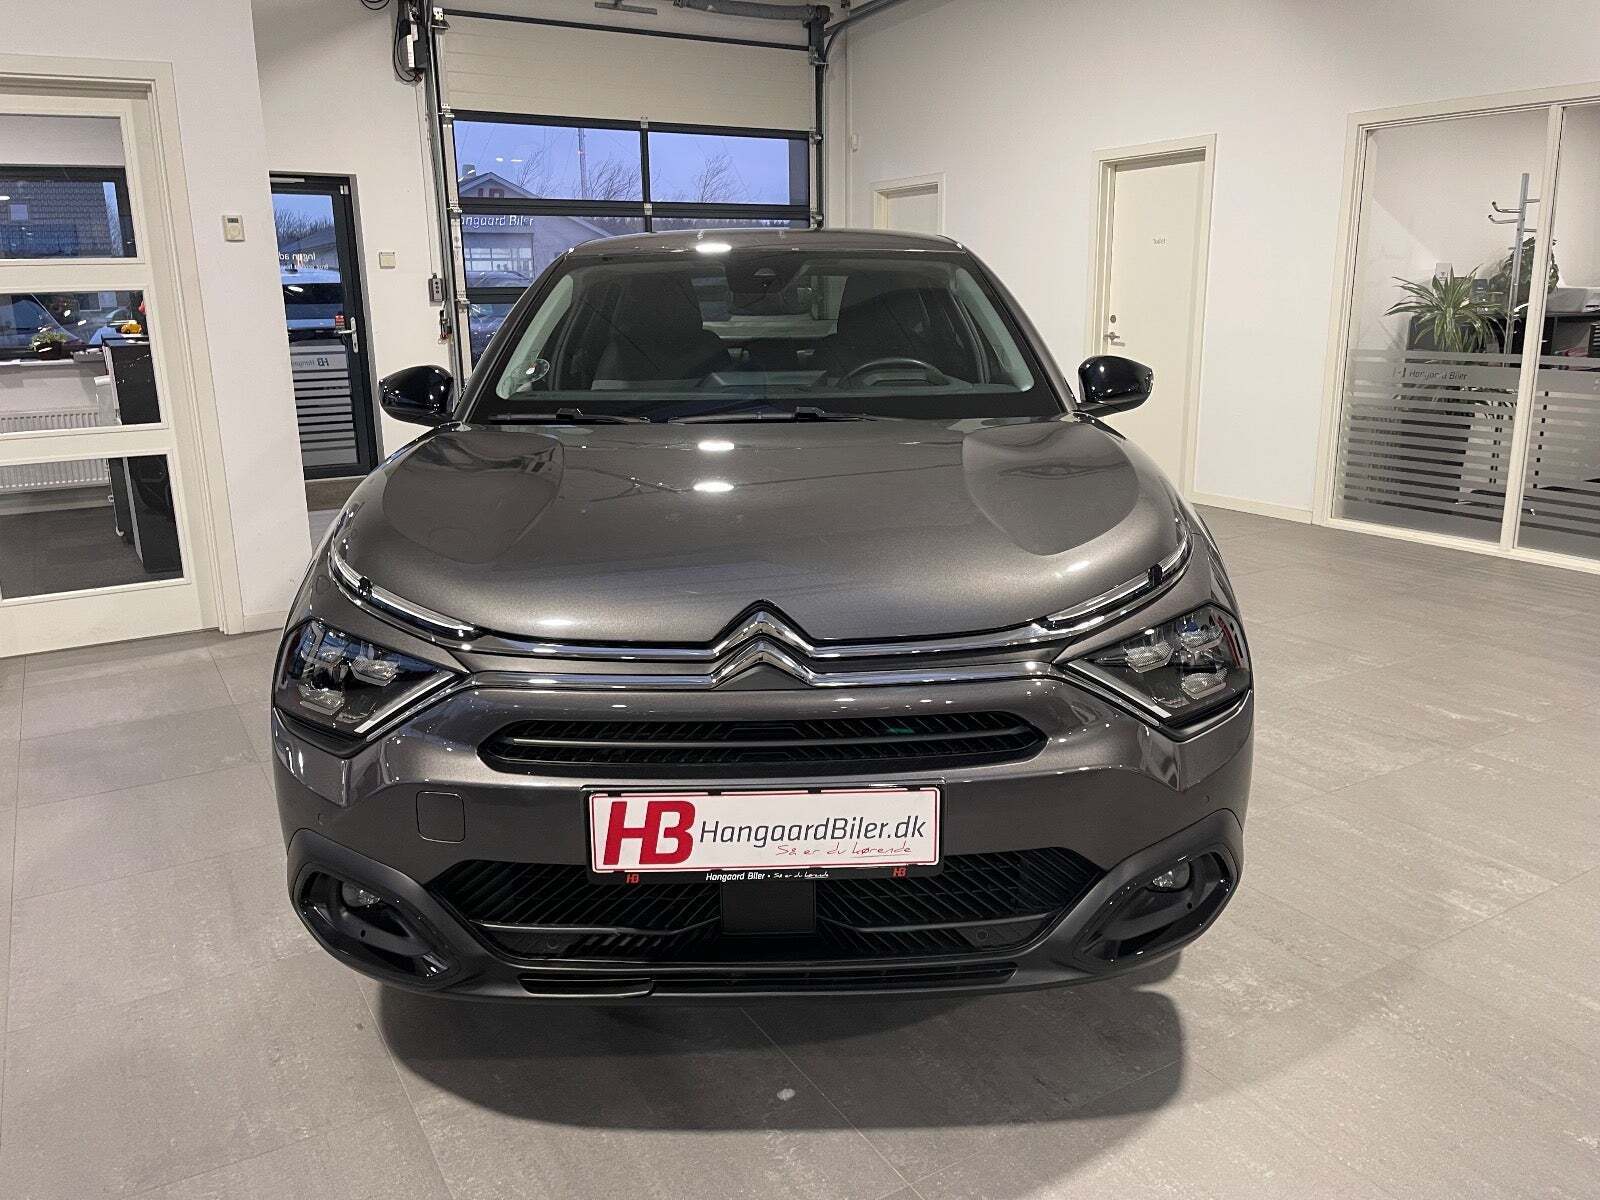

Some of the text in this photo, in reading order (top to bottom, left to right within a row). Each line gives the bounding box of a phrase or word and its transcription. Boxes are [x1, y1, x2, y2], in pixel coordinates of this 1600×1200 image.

[603, 801, 696, 865] HB
[700, 815, 926, 848] HangaardBiler.dk
[626, 874, 640, 884] HB
[706, 872, 745, 882] Hangaard
[747, 871, 766, 880] Biler
